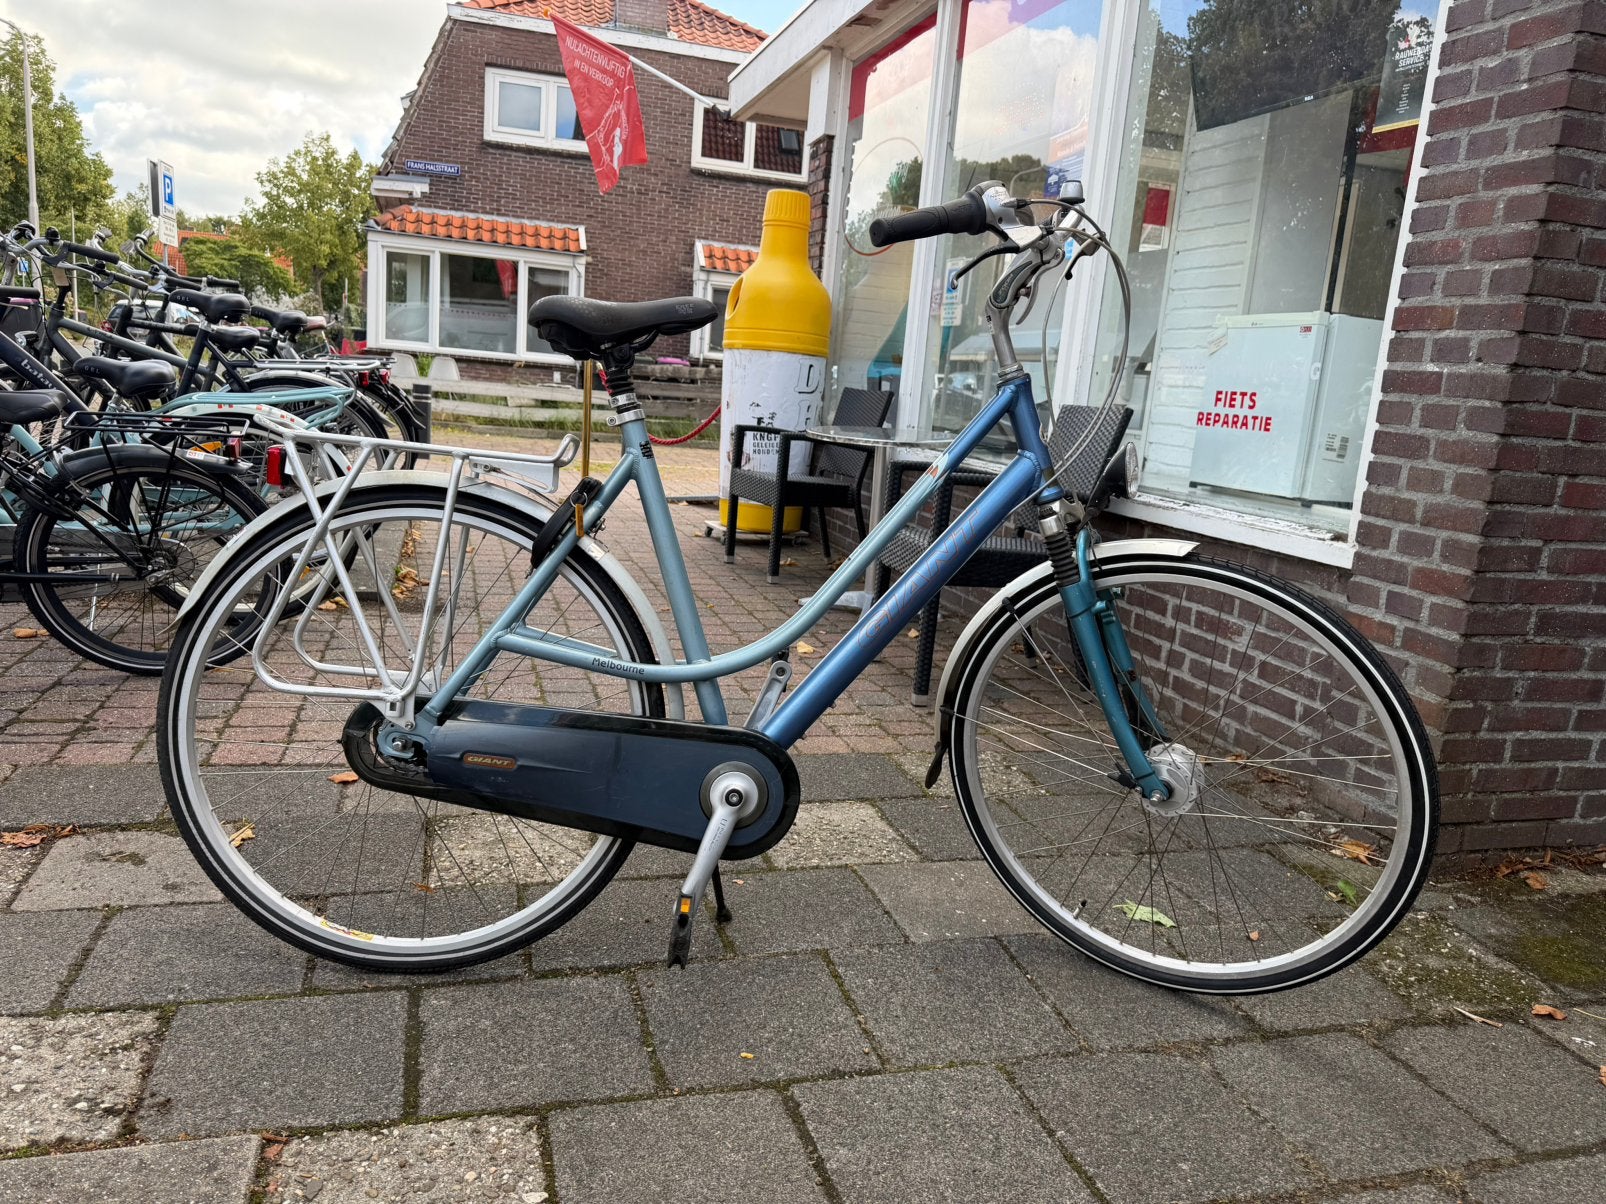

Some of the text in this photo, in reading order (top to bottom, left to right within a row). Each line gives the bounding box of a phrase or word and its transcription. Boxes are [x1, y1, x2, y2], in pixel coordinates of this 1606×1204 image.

[1399, 54, 1425, 67] SERVICE
[574, 59, 615, 88] IN EN VERKOOP
[407, 161, 459, 174] FRANS HALSSTRAAT
[1213, 390, 1258, 410] FIETS
[1196, 411, 1273, 433] REPARATIE
[752, 432, 780, 442] KNGF
[865, 508, 979, 640] GIANT
[591, 657, 645, 675] Melbourne
[467, 756, 511, 766] GIANT
